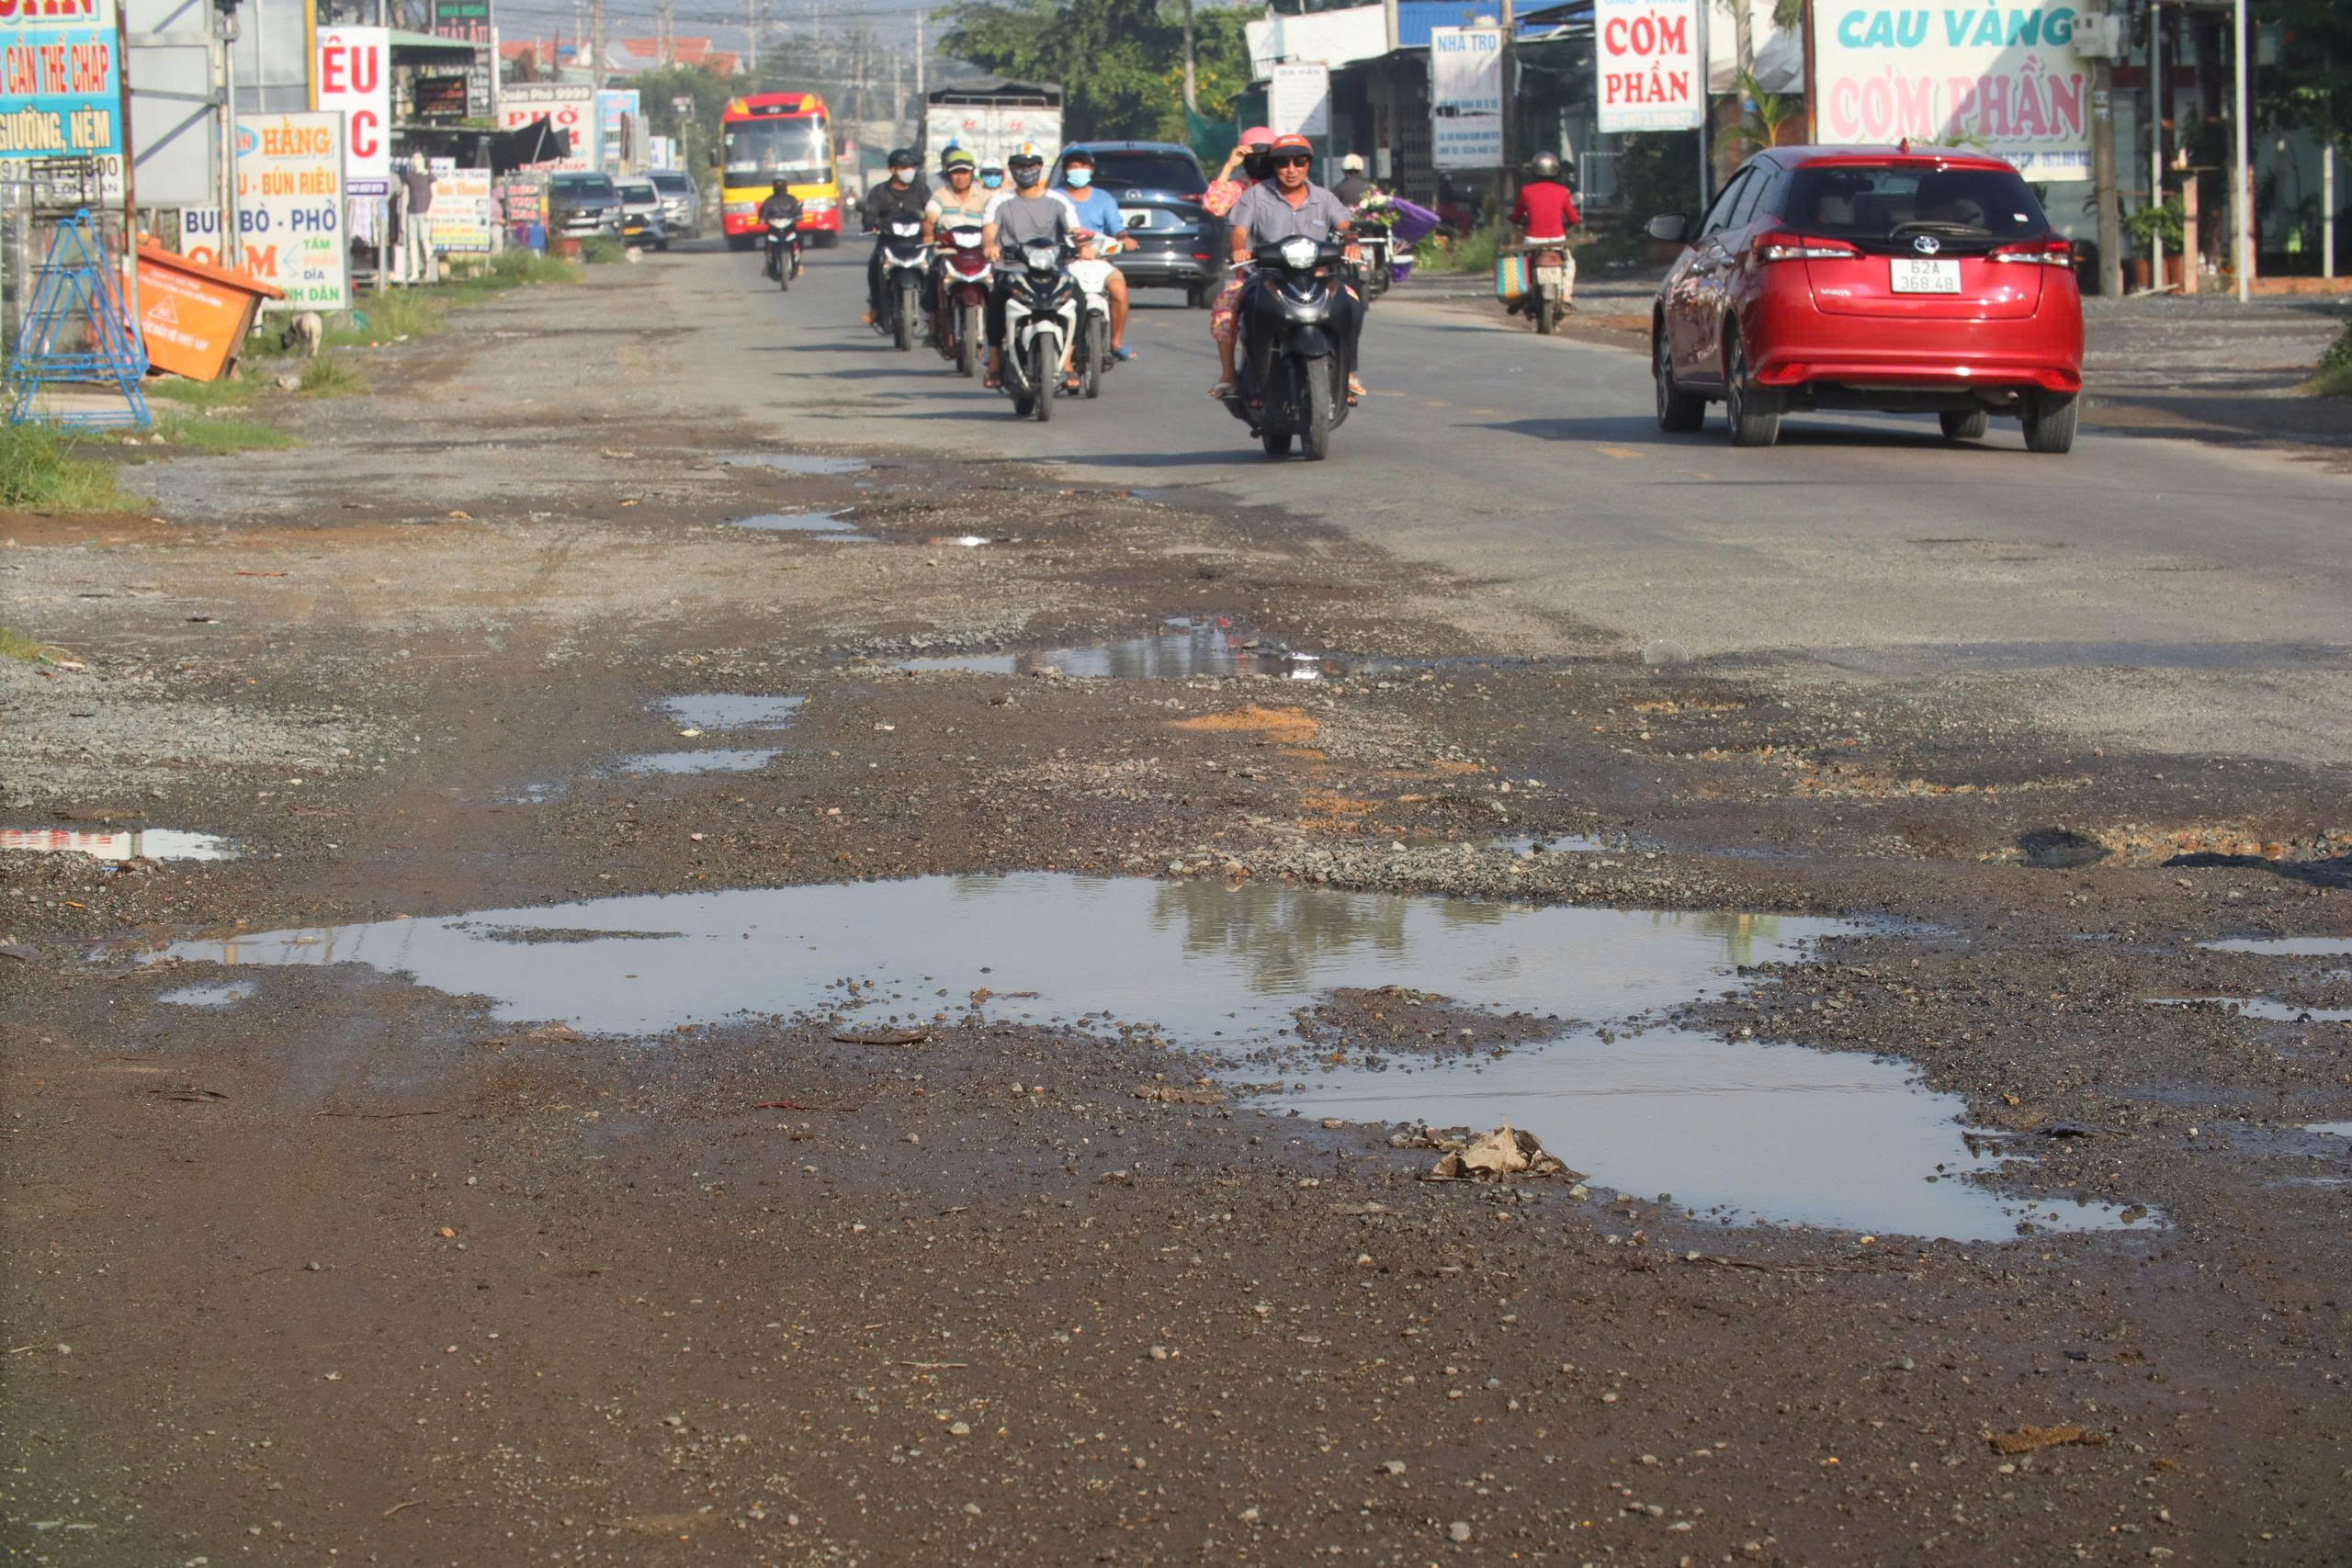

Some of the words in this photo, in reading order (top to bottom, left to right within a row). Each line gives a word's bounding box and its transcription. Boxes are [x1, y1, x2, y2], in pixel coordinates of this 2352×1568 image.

[1604, 8, 1688, 56] CƠM
[1838, 9, 1929, 48] CAU
[1944, 0, 2075, 47] VÀNG
[1605, 60, 1689, 104] PHẦN
[1829, 65, 1933, 138] CƠM
[1947, 54, 2084, 138] PHẦN
[239, 202, 270, 232] BÒ
[291, 199, 337, 231] PHỞ
[1911, 261, 1940, 274] 62A
